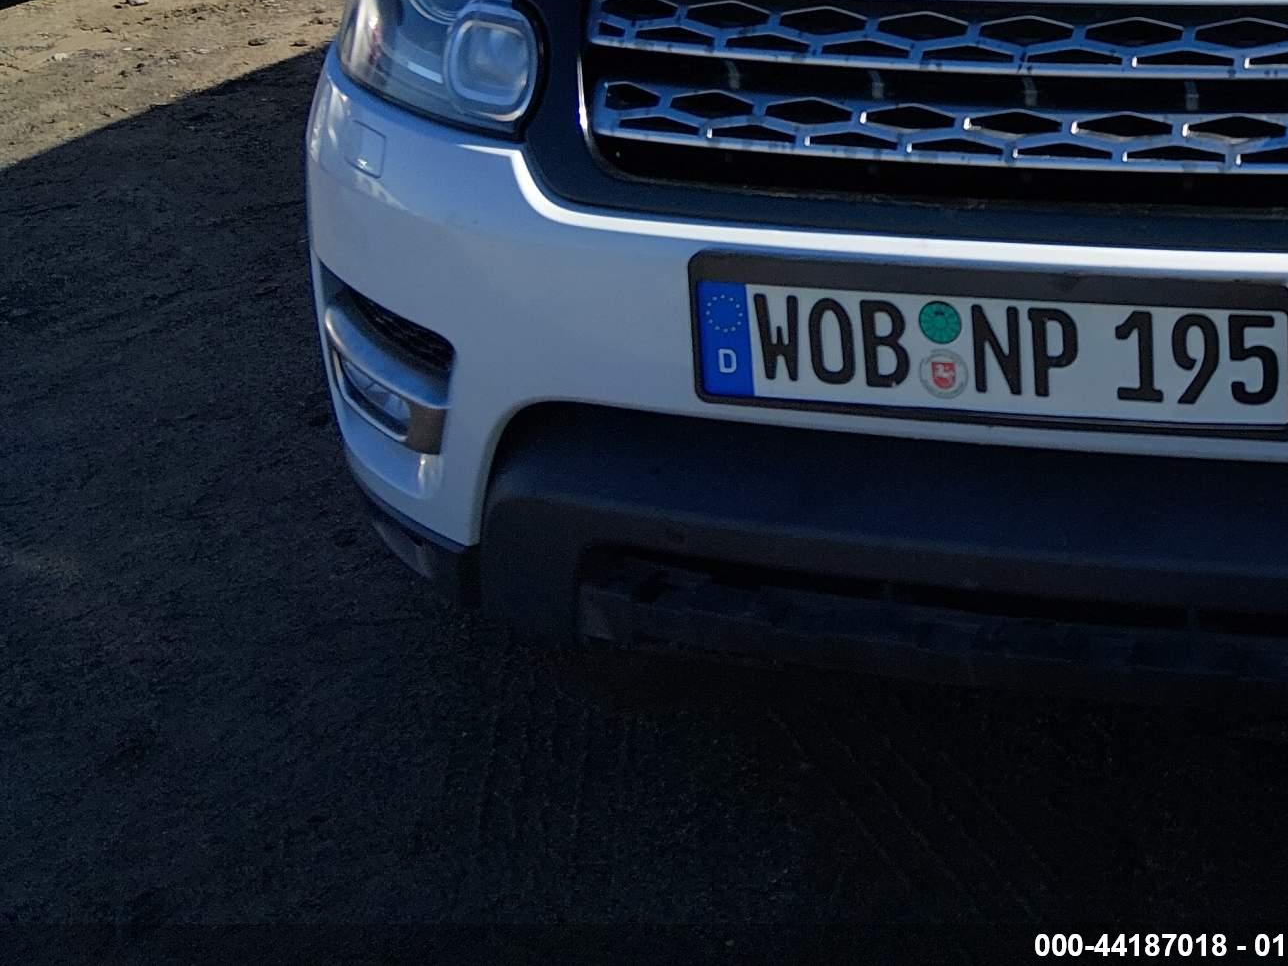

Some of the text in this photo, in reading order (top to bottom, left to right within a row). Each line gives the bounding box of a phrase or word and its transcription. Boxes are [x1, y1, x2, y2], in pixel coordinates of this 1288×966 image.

[717, 348, 737, 374] D
[753, 292, 1280, 406] WOB NP 195
